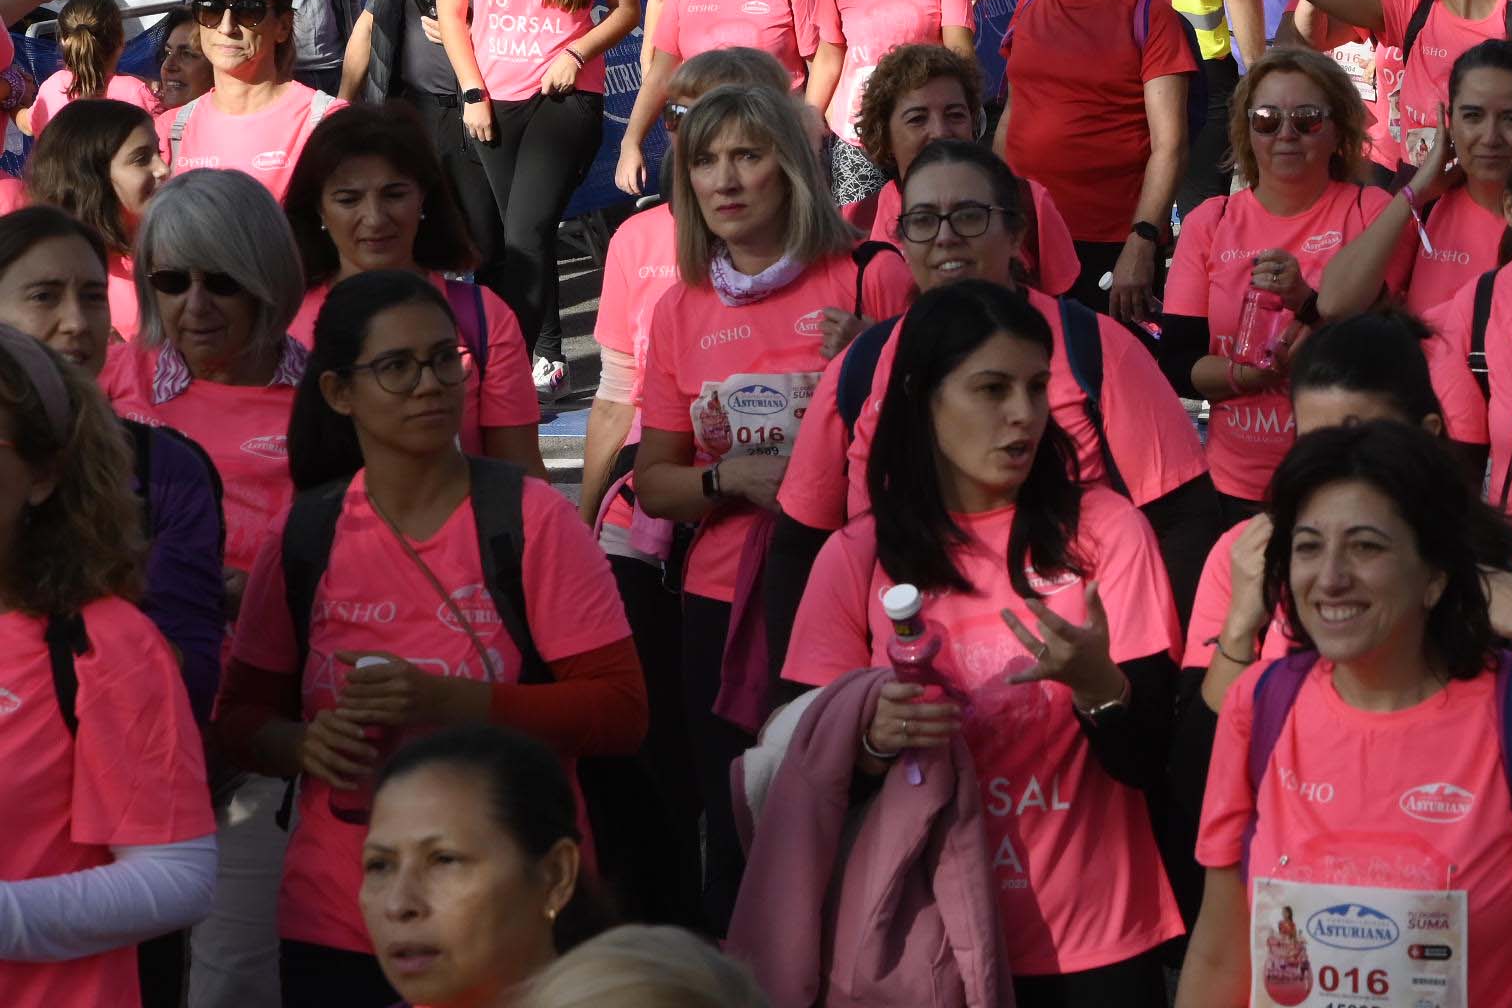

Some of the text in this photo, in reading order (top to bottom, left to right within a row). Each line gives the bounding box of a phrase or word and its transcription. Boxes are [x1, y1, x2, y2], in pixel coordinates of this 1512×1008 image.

[488, 13, 564, 34] DORSAL
[487, 37, 543, 56] SUMA
[639, 264, 681, 279] OYSH
[700, 324, 751, 350] OYSHO
[733, 395, 784, 408] ASTURIANA
[736, 426, 784, 445] 016
[1312, 919, 1450, 942] ASTURIANA SUMA
[1318, 966, 1390, 996] 016
